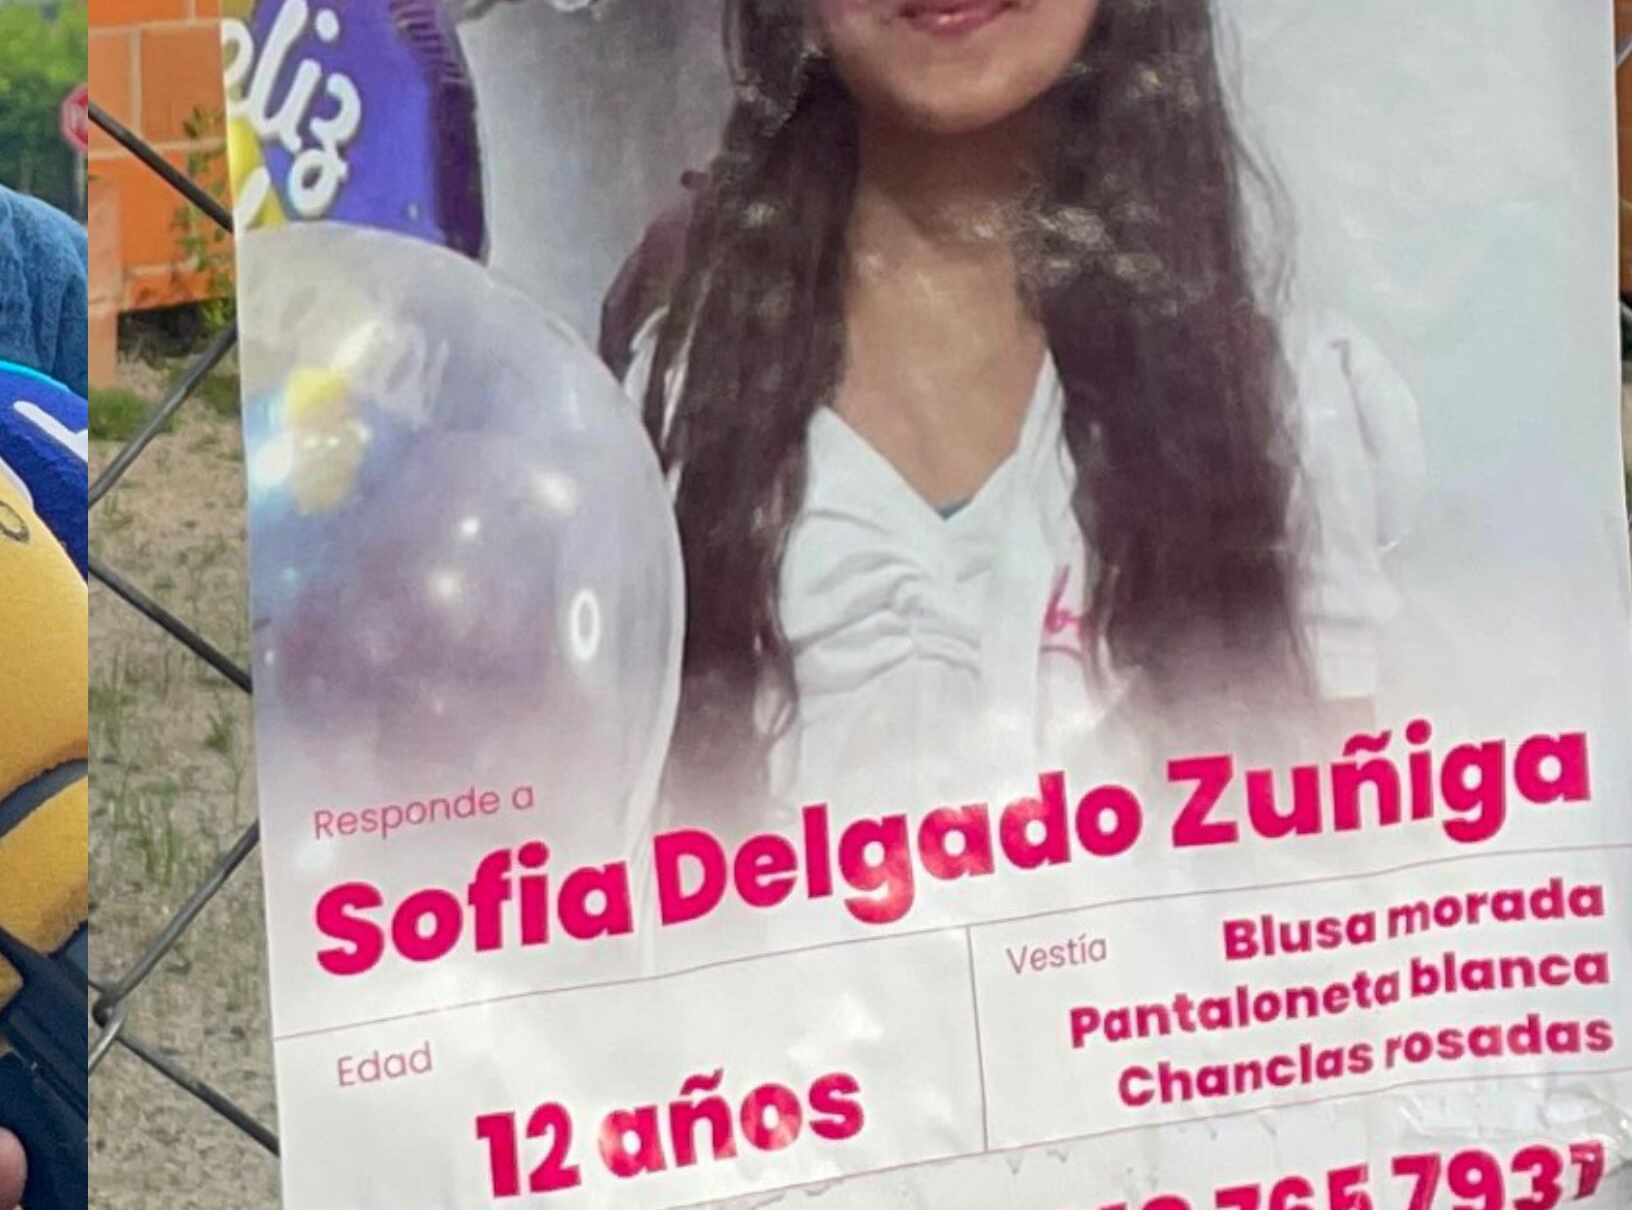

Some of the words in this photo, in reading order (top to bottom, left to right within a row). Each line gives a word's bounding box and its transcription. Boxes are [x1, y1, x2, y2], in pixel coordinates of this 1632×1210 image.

[313, 787, 500, 840] Responde
[513, 784, 536, 812] a
[314, 839, 635, 977] Sofia
[652, 769, 1143, 927] Delgado
[1165, 718, 1592, 849] Zuñiga
[1006, 933, 1109, 976] Vestía
[1222, 914, 1377, 961] Blusa
[1387, 877, 1605, 938] morada
[1068, 969, 1400, 1049] Pantaloneta
[1409, 950, 1610, 999] blanca
[336, 1041, 434, 1088] Edad
[1117, 1042, 1374, 1108] Chanclas
[1384, 1012, 1615, 1070] rosadas
[474, 1099, 582, 1199] 12
[597, 1067, 865, 1181] años
